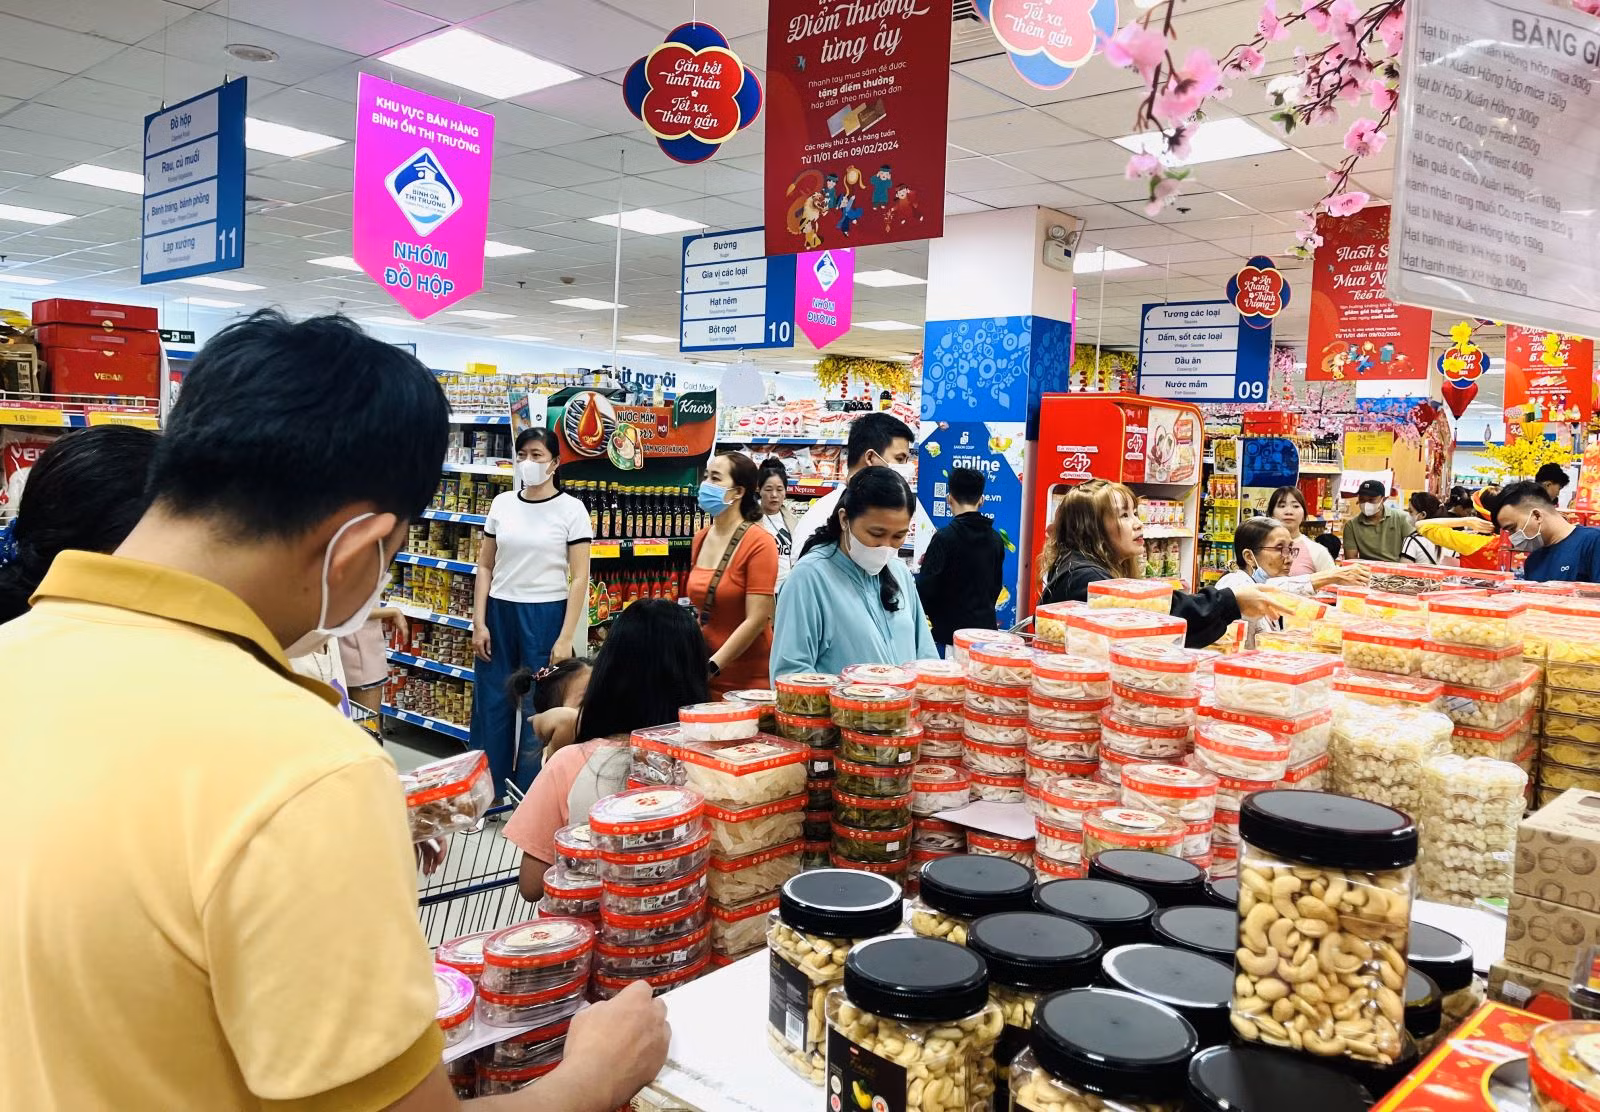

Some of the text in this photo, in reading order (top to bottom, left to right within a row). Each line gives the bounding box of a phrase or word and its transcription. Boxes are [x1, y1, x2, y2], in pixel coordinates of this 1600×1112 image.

[1023, 2, 1063, 26] Tết xa
[787, 6, 841, 44] Điểm
[1005, 13, 1073, 48] thêm gần
[821, 18, 902, 64] từng ấy
[1512, 18, 1577, 56] BẢNG
[675, 57, 723, 75] Gắn kết
[808, 78, 830, 88] Nhanh
[831, 75, 843, 84] tay
[844, 71, 861, 80] mua
[818, 75, 895, 99] tặng điểm thưởng
[1478, 66, 1504, 88] Hồng
[1524, 85, 1545, 101] mica
[1551, 68, 1569, 84] mica
[1571, 74, 1592, 95] 330g
[671, 96, 708, 112] Tết xa
[841, 94, 857, 103] theo
[376, 96, 479, 137] KHU VỰC BÁN HÀNG
[1464, 89, 1489, 110] Xuân
[1490, 97, 1516, 120] Hồng
[1517, 107, 1540, 128] 300g
[655, 109, 718, 130] thêm gần
[372, 112, 398, 129] BÌNH
[418, 127, 435, 143] THỊ
[436, 132, 480, 154] TRƯỜNG
[1459, 116, 1487, 138] Co.op
[1518, 135, 1540, 156] 250g
[804, 142, 816, 151] Các
[857, 134, 862, 142] 4
[801, 140, 899, 165] Từ 11/01 đến 09/02/2024
[219, 227, 236, 259] 11
[713, 240, 737, 251] Đường
[394, 240, 448, 269] NHÓM
[1336, 243, 1376, 262] Flash
[385, 263, 454, 299] ĐỒ HỘP
[702, 266, 748, 280] Gia vị các loại
[1333, 273, 1367, 289] Mua
[710, 297, 721, 308] Hạt
[1163, 308, 1221, 319] Tương các loại
[708, 324, 737, 335] Bột ngọt
[768, 321, 791, 343] 10
[1158, 332, 1177, 342] Dấm,
[1192, 332, 1206, 341] các
[1208, 332, 1223, 342] loại
[1174, 356, 1190, 365] Dầu
[94, 372, 124, 382] VEDAN
[1165, 379, 1208, 388] Nước mắm
[1238, 381, 1264, 399] 09
[617, 408, 638, 423] NƯỚC
[679, 399, 714, 415] Knorr
[952, 455, 1001, 472] online
